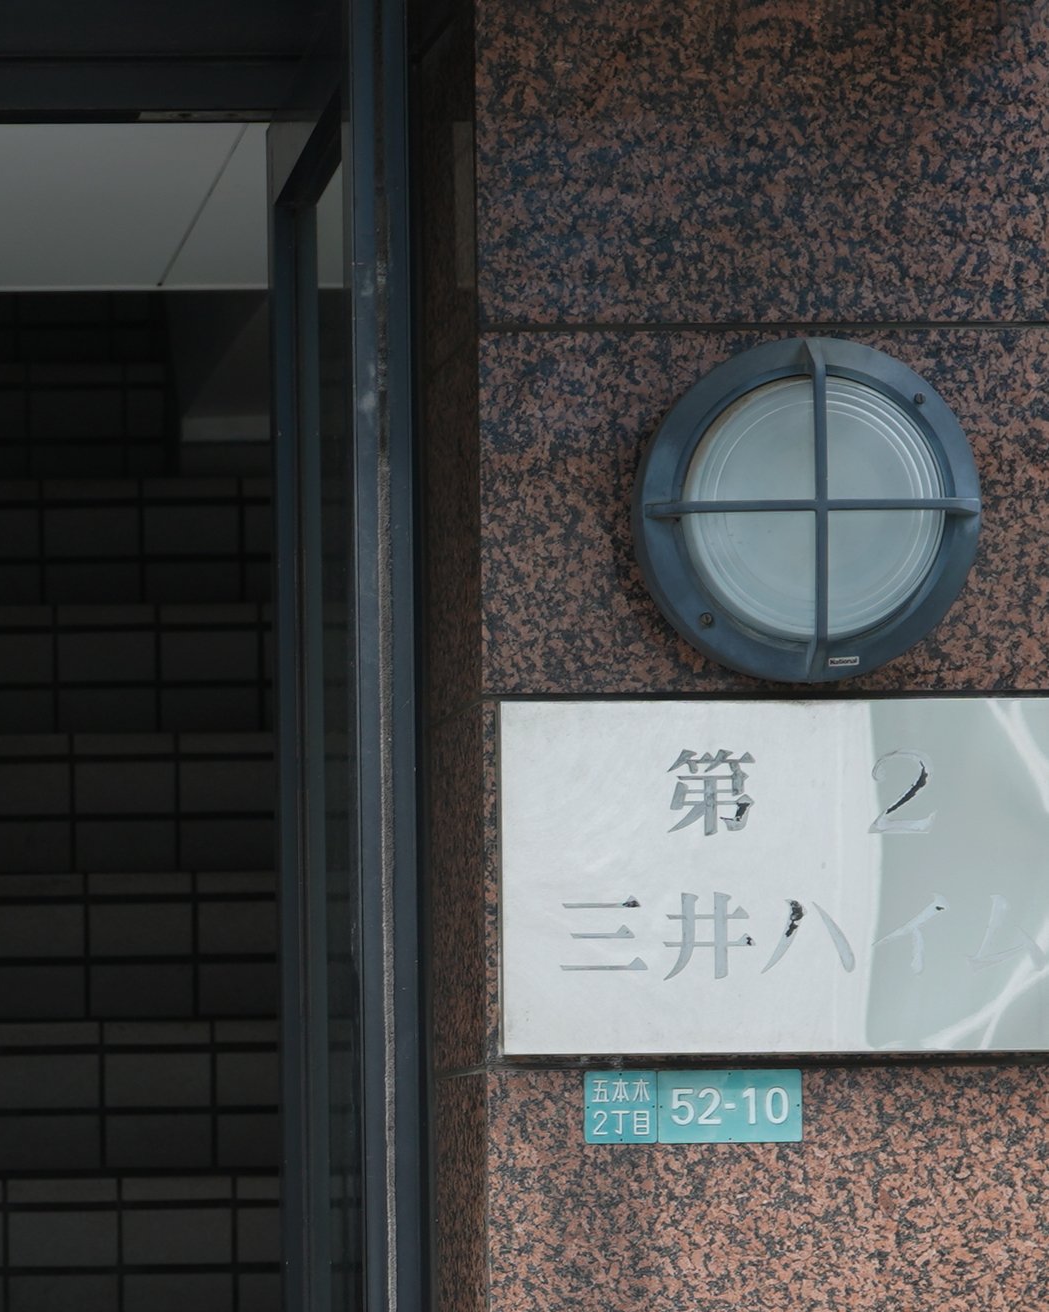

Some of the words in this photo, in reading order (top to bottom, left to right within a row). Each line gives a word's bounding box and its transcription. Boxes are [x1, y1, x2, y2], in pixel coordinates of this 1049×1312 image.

[829, 657, 858, 666] National
[559, 891, 1047, 981] 三井ハイム
[592, 1078, 650, 1103] 五本木
[671, 1087, 790, 1126] 52-10
[593, 1110, 650, 1136] 2丁目
